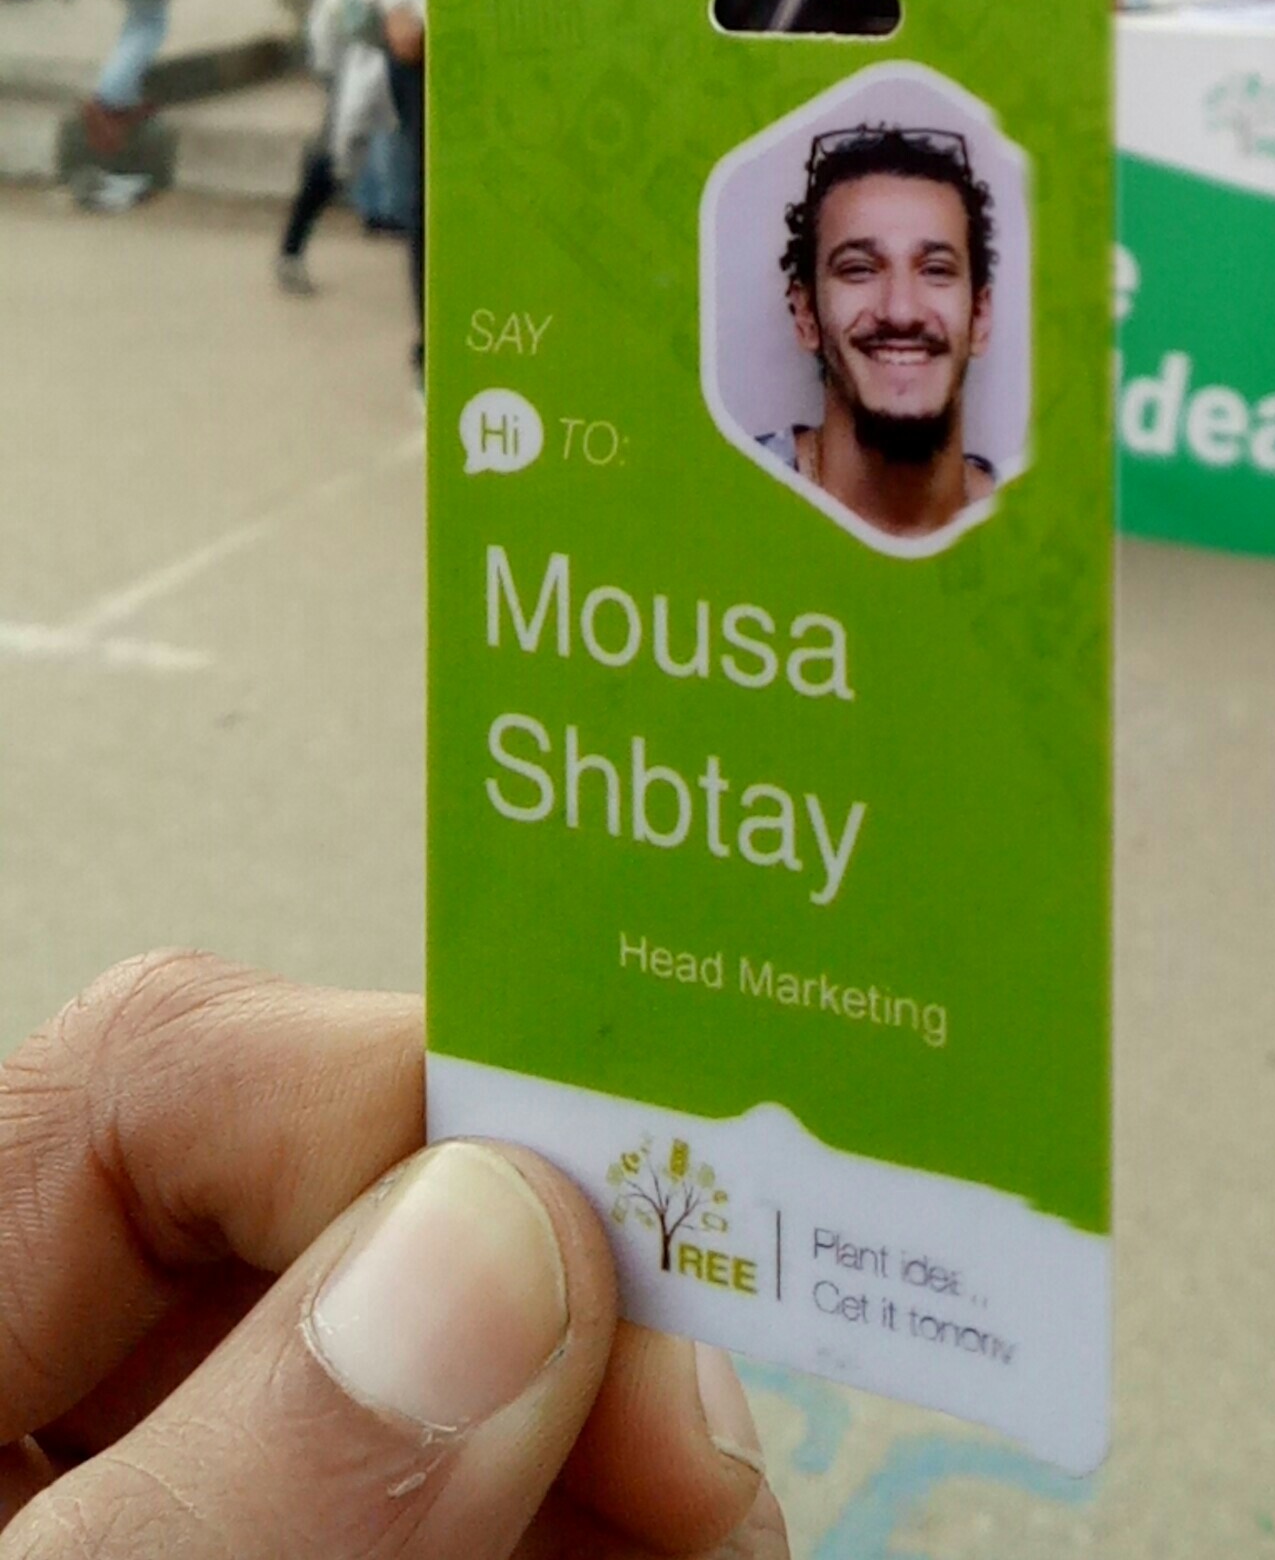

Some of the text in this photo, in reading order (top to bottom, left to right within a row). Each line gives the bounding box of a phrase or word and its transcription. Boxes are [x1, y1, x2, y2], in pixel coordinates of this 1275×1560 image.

[466, 308, 554, 355] SAY
[480, 412, 629, 467] Hi TO:
[486, 545, 855, 701] Mousa
[486, 713, 867, 905] Shbtay
[618, 932, 949, 1048] Head Marketing
[813, 1227, 889, 1278] Plant
